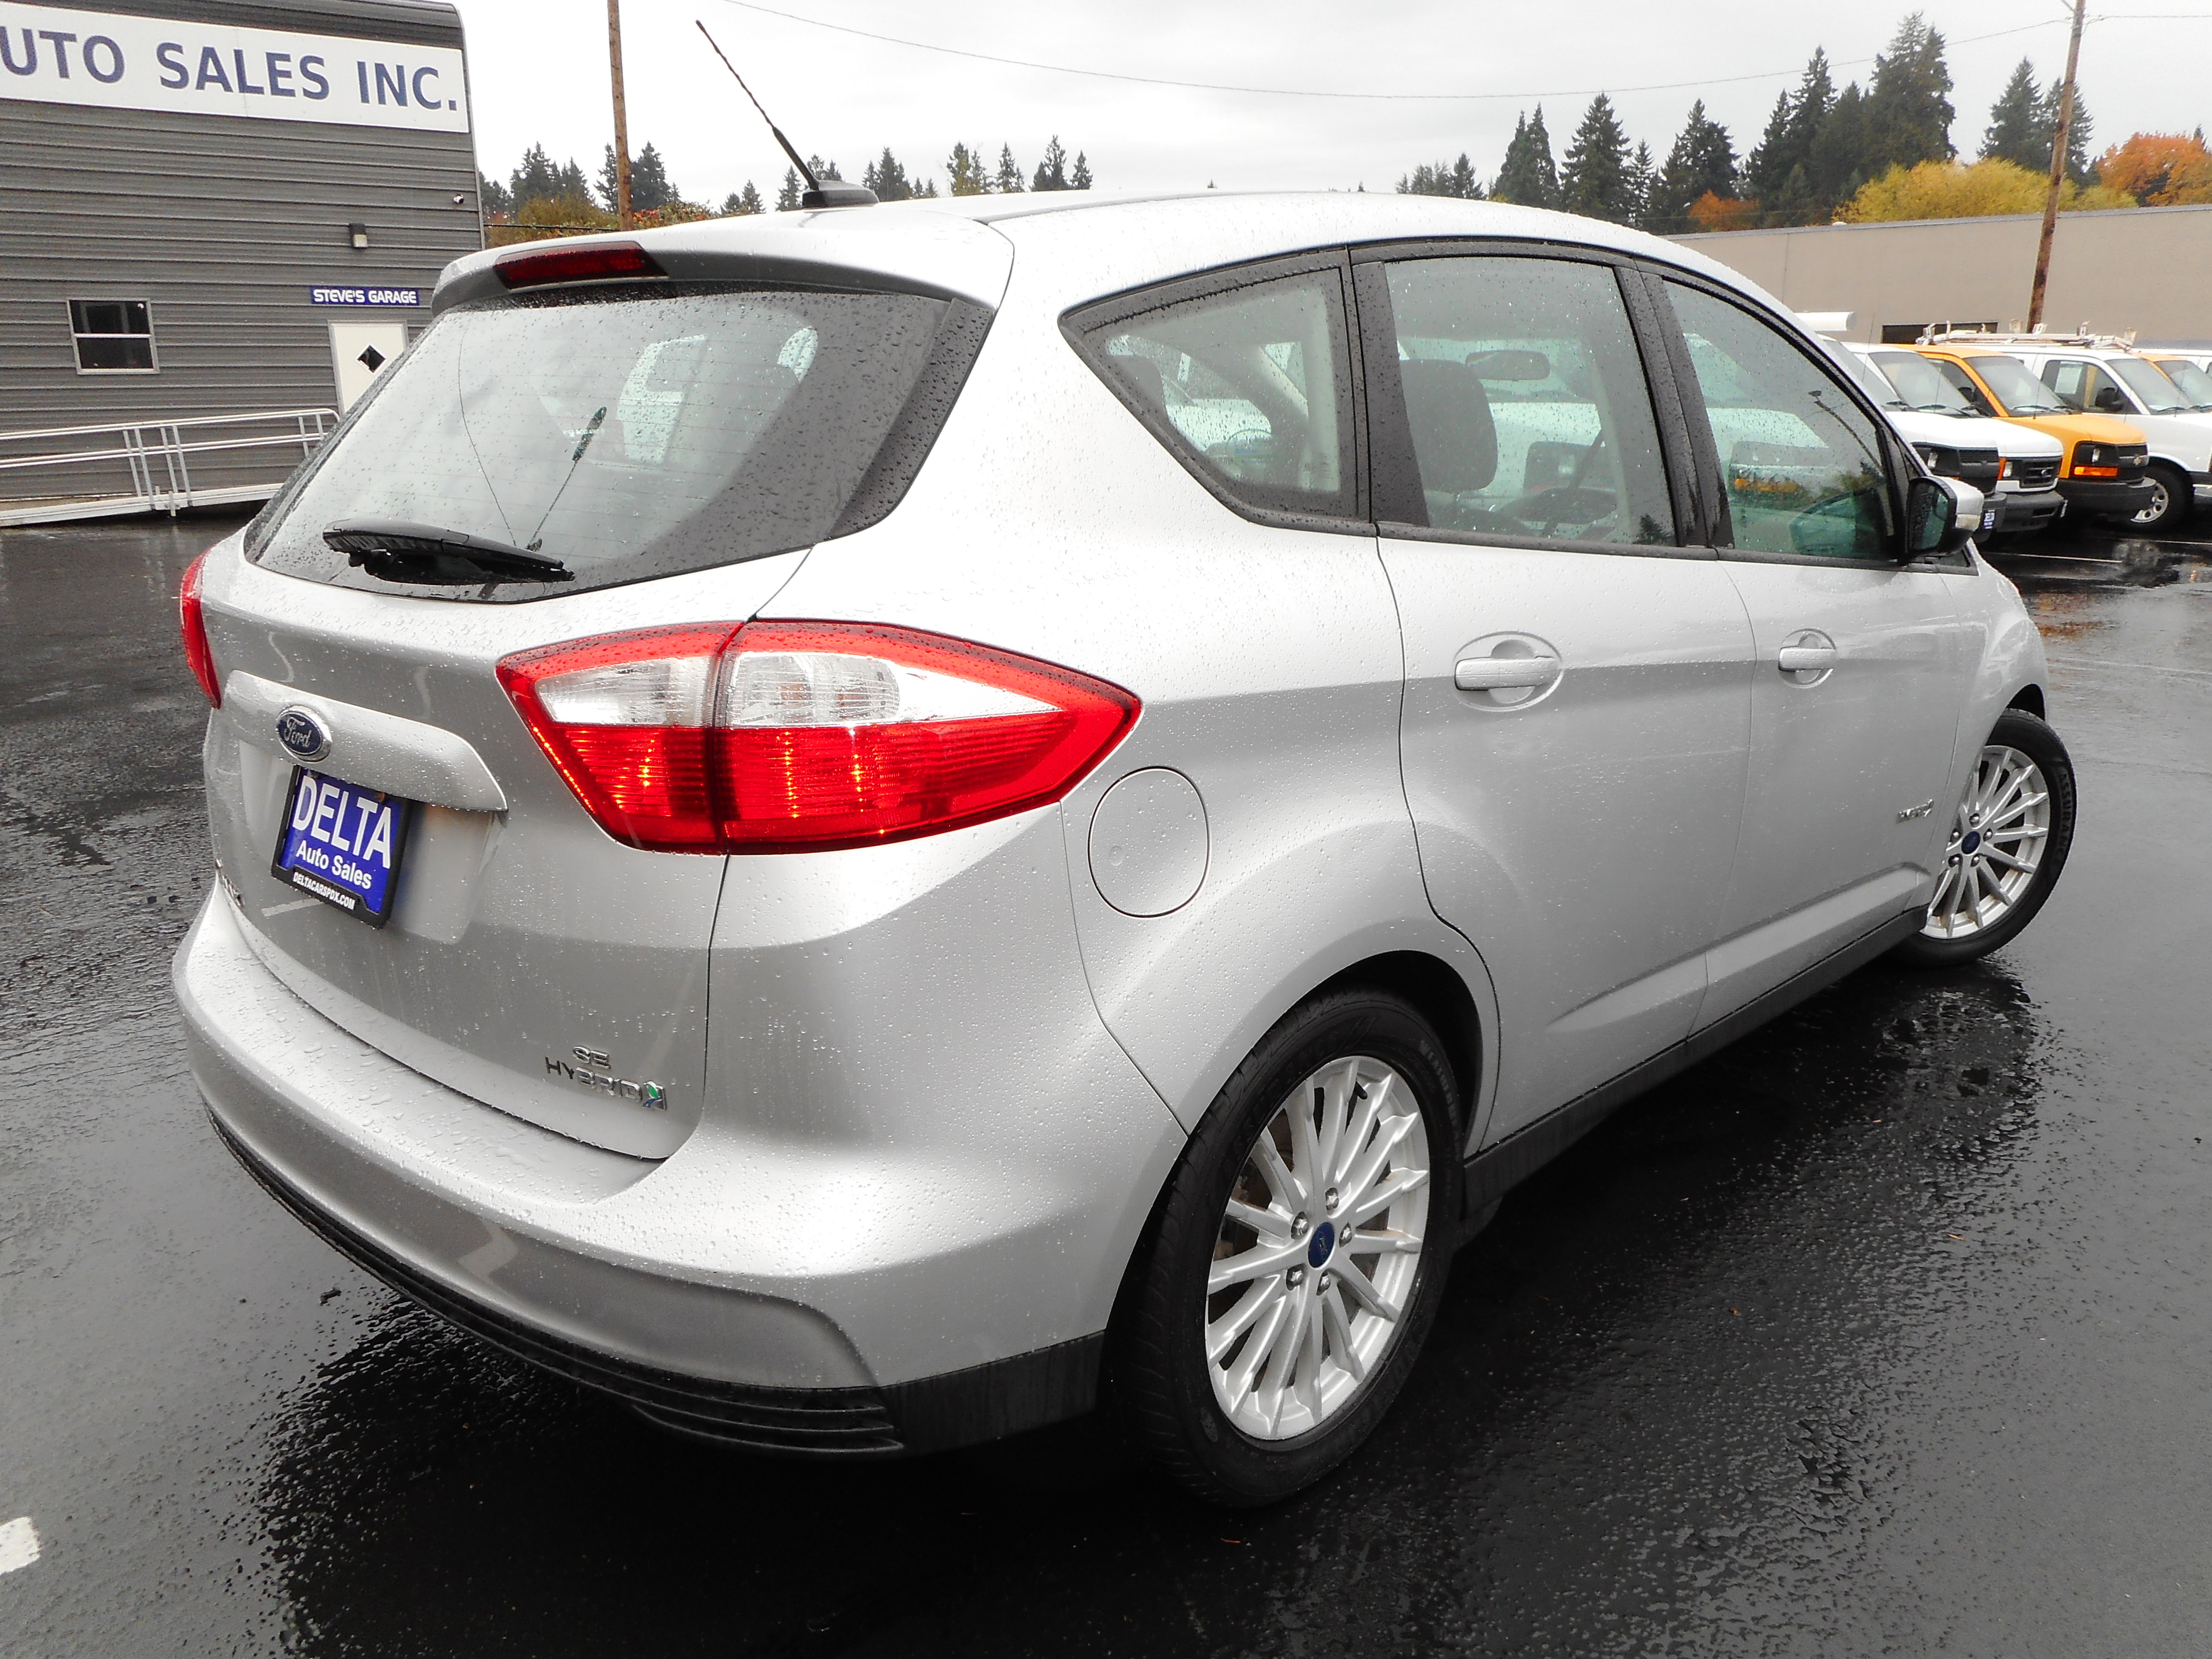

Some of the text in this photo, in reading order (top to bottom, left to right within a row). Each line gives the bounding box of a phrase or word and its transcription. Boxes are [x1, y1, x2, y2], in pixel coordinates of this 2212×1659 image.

[0, 26, 458, 112] UTO SALES INC.
[313, 289, 417, 304] STEVE'S GARAGE
[284, 717, 312, 747] Ford
[292, 775, 391, 869] DELTA
[296, 840, 372, 890] Auto Sales
[293, 872, 356, 910] DELTACARSPDX.COM
[572, 1045, 611, 1069] SE
[545, 1057, 643, 1103] HYBRID
